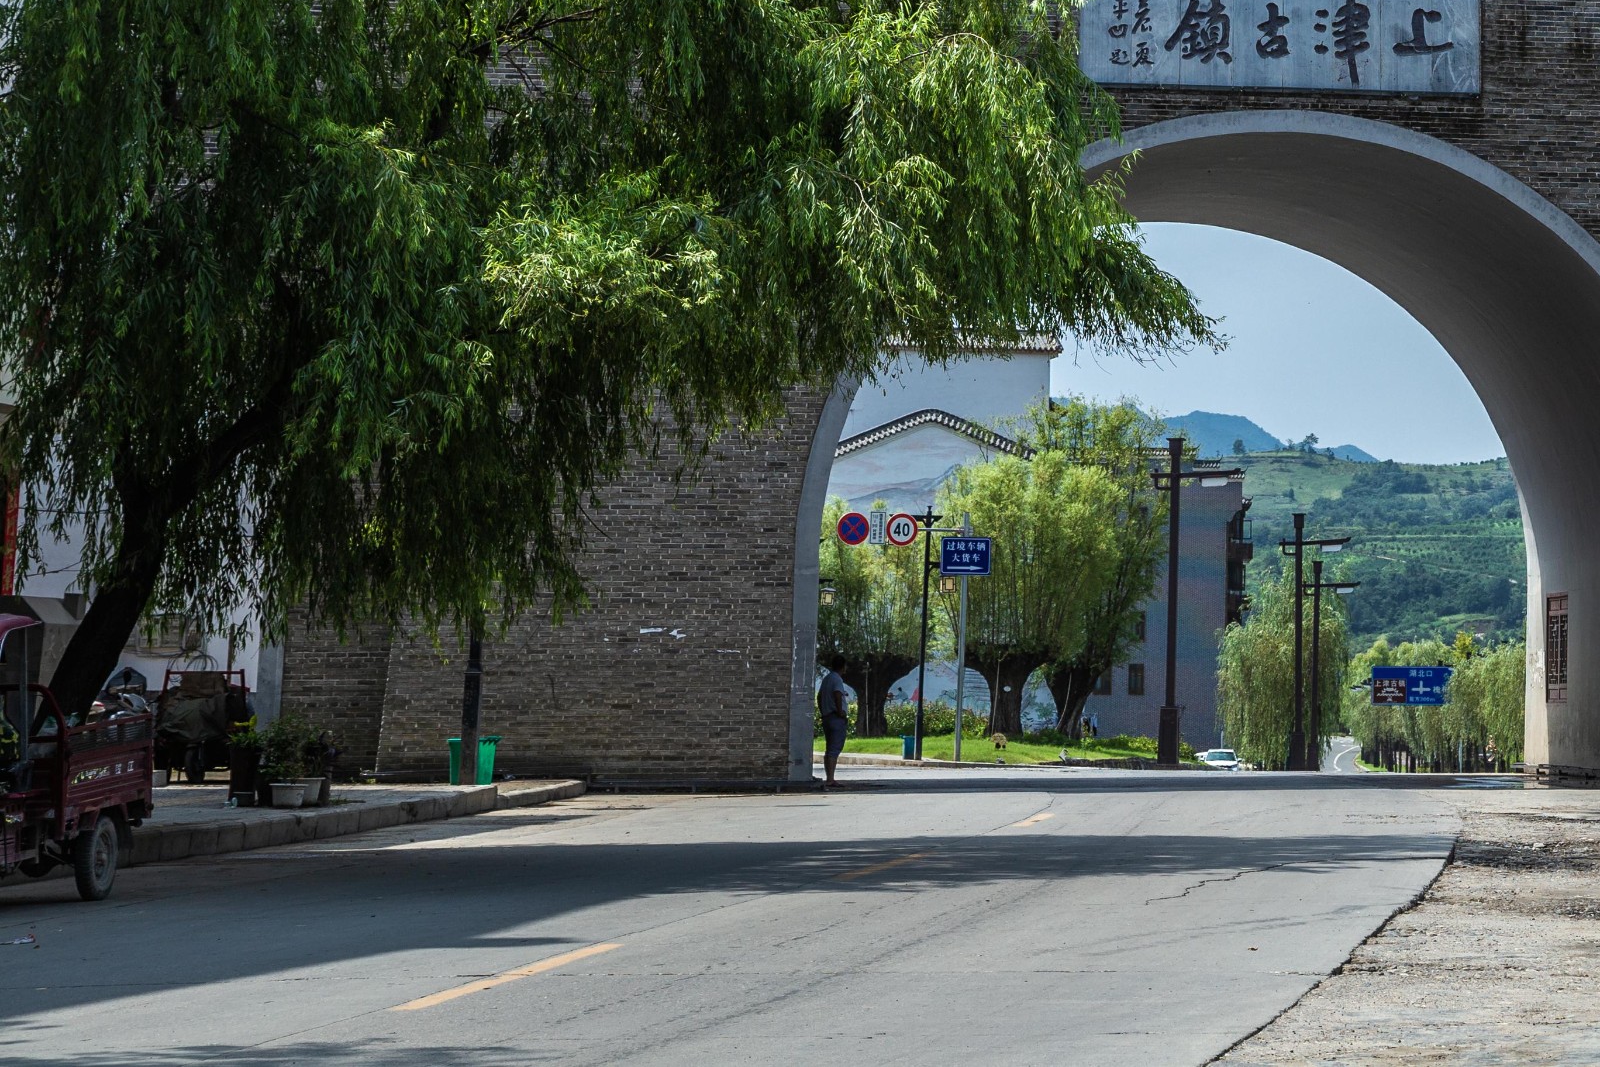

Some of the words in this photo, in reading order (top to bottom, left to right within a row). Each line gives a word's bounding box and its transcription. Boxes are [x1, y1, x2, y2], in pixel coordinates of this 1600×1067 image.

[893, 522, 910, 537] 40
[946, 541, 986, 551] 过境车辆
[952, 553, 981, 563] 大货车
[1409, 669, 1433, 678] 湖北口
[1374, 679, 1406, 687] 上津古镇
